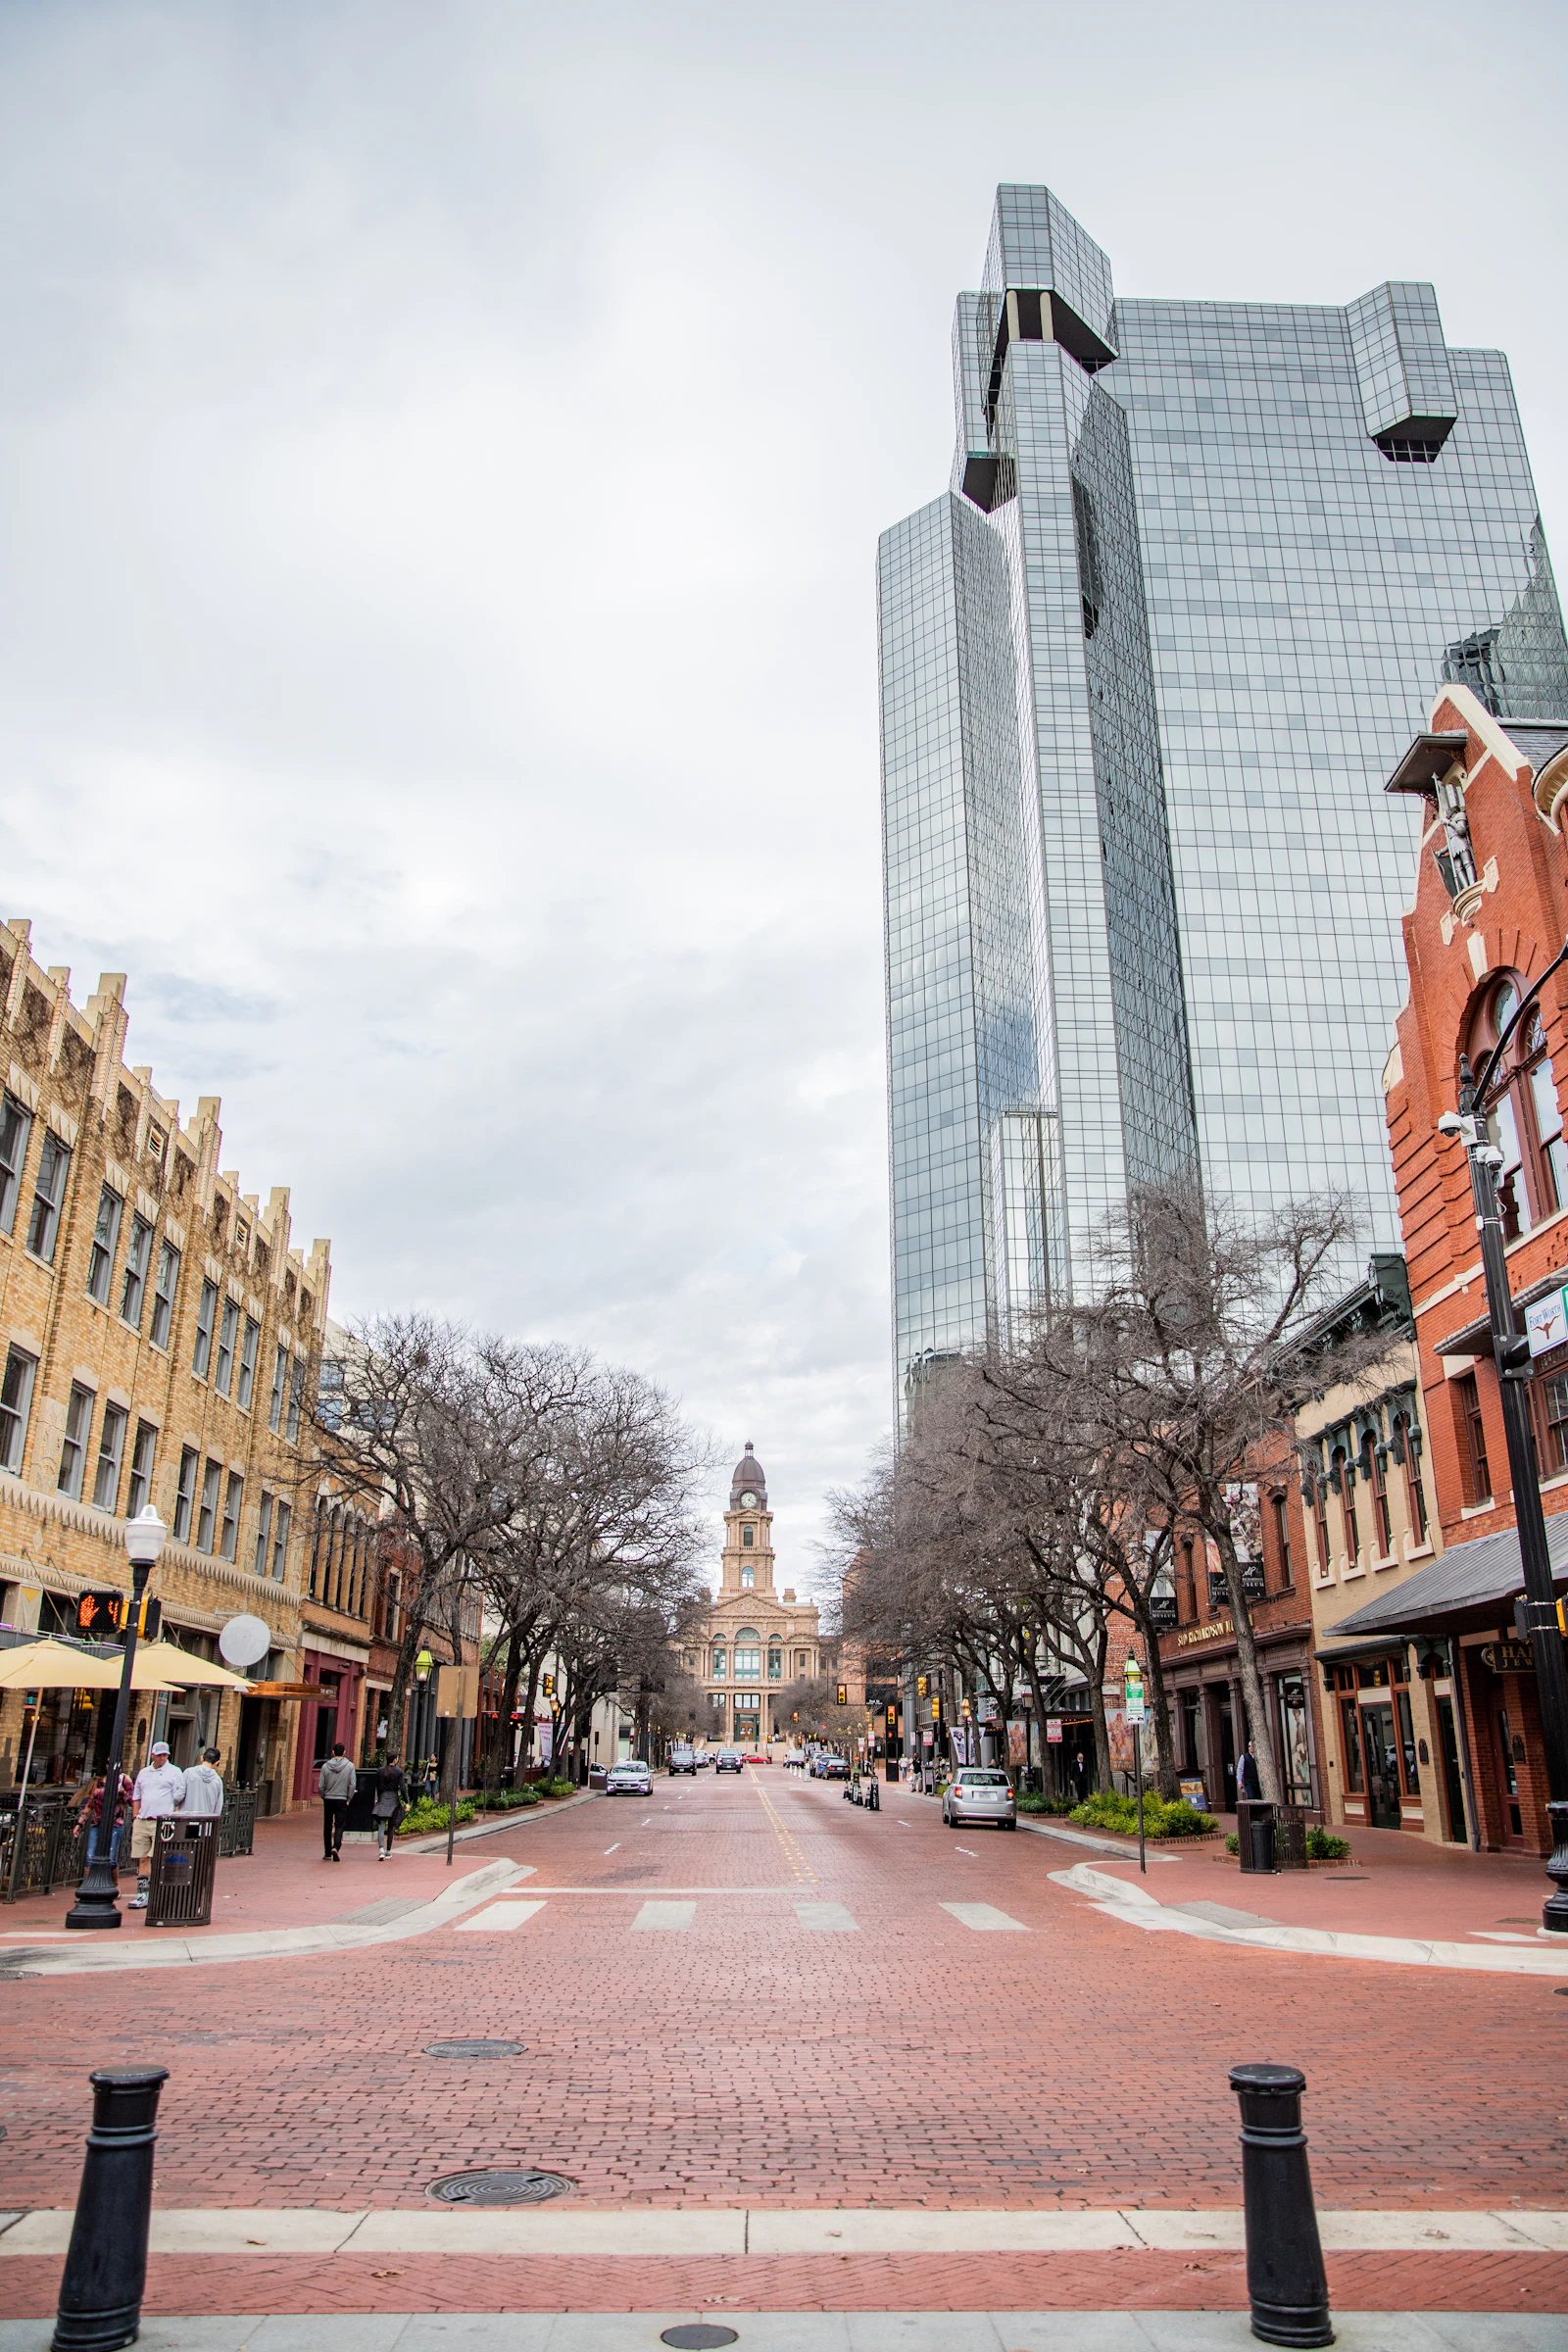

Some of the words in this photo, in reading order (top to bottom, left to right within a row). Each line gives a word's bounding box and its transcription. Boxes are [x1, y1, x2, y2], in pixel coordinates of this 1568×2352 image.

[1529, 1314, 1543, 1328] FORT
[1542, 1303, 1561, 1320] WORTH
[108, 1599, 120, 1625] 4
